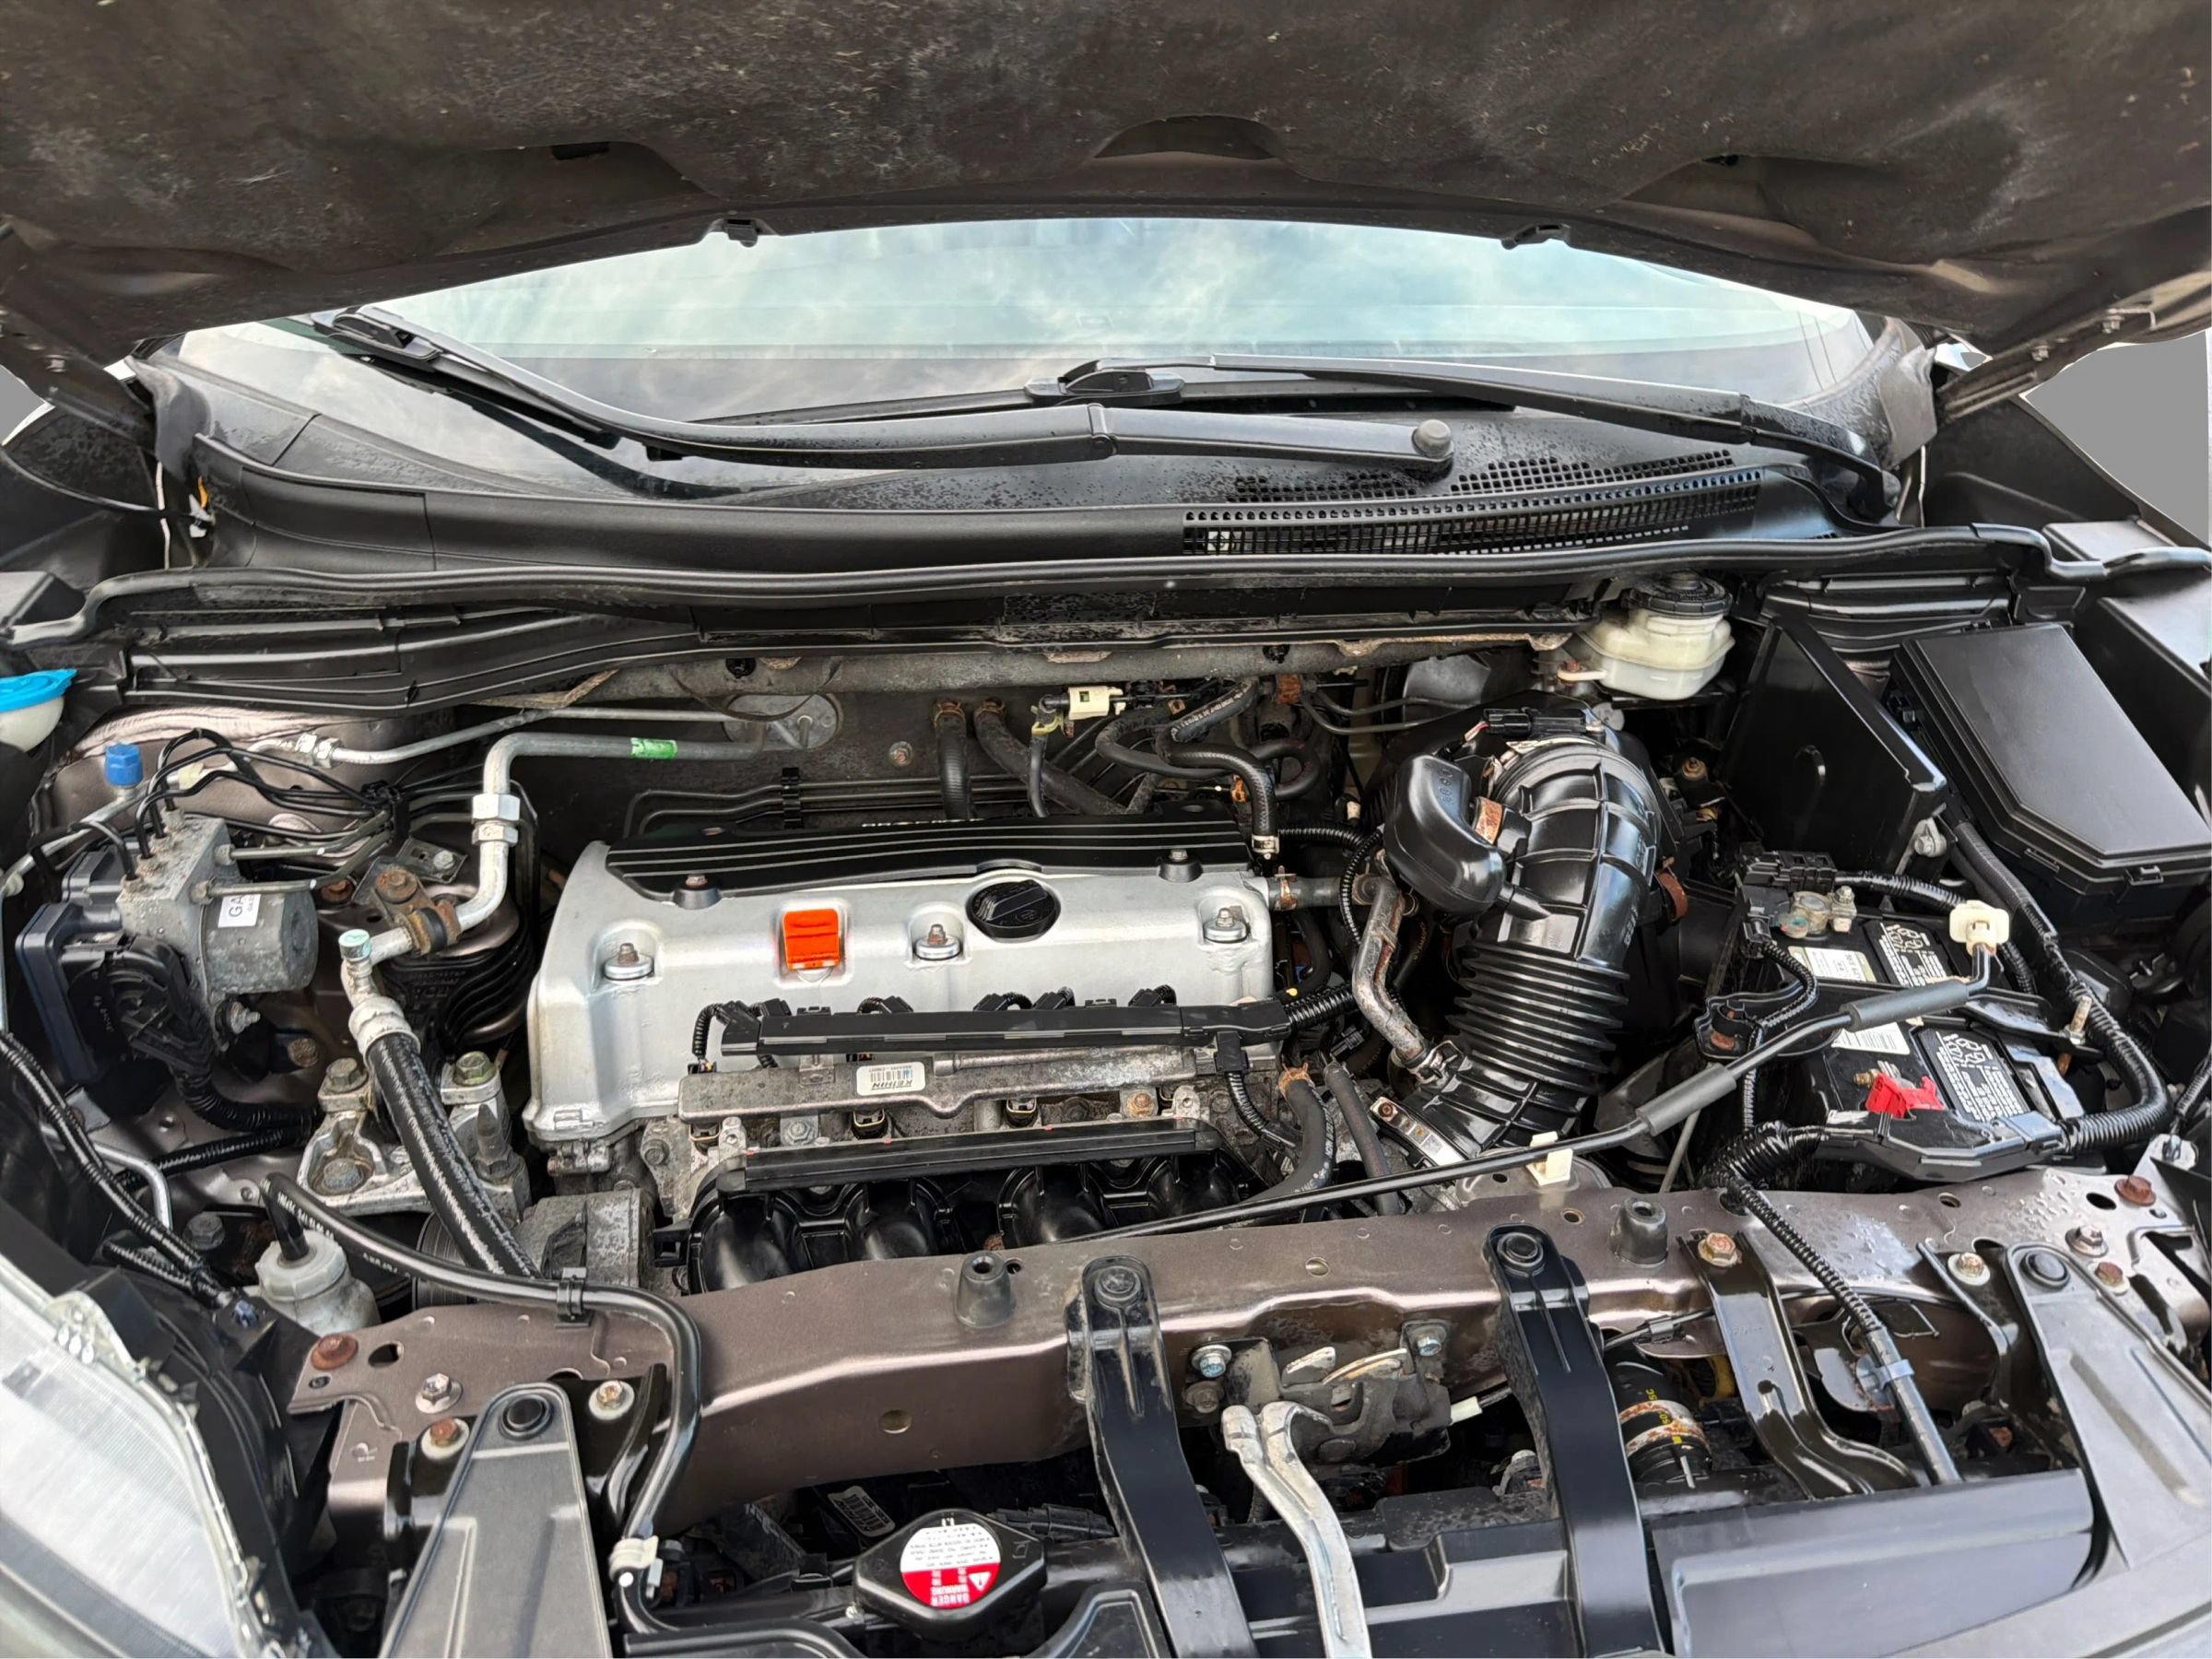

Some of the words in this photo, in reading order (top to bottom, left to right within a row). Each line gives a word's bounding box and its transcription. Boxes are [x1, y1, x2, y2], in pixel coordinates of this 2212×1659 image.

[870, 1079, 912, 1091] KEIHIN
[930, 1583, 970, 1595] WARNING
[929, 1593, 970, 1606] DANGER
